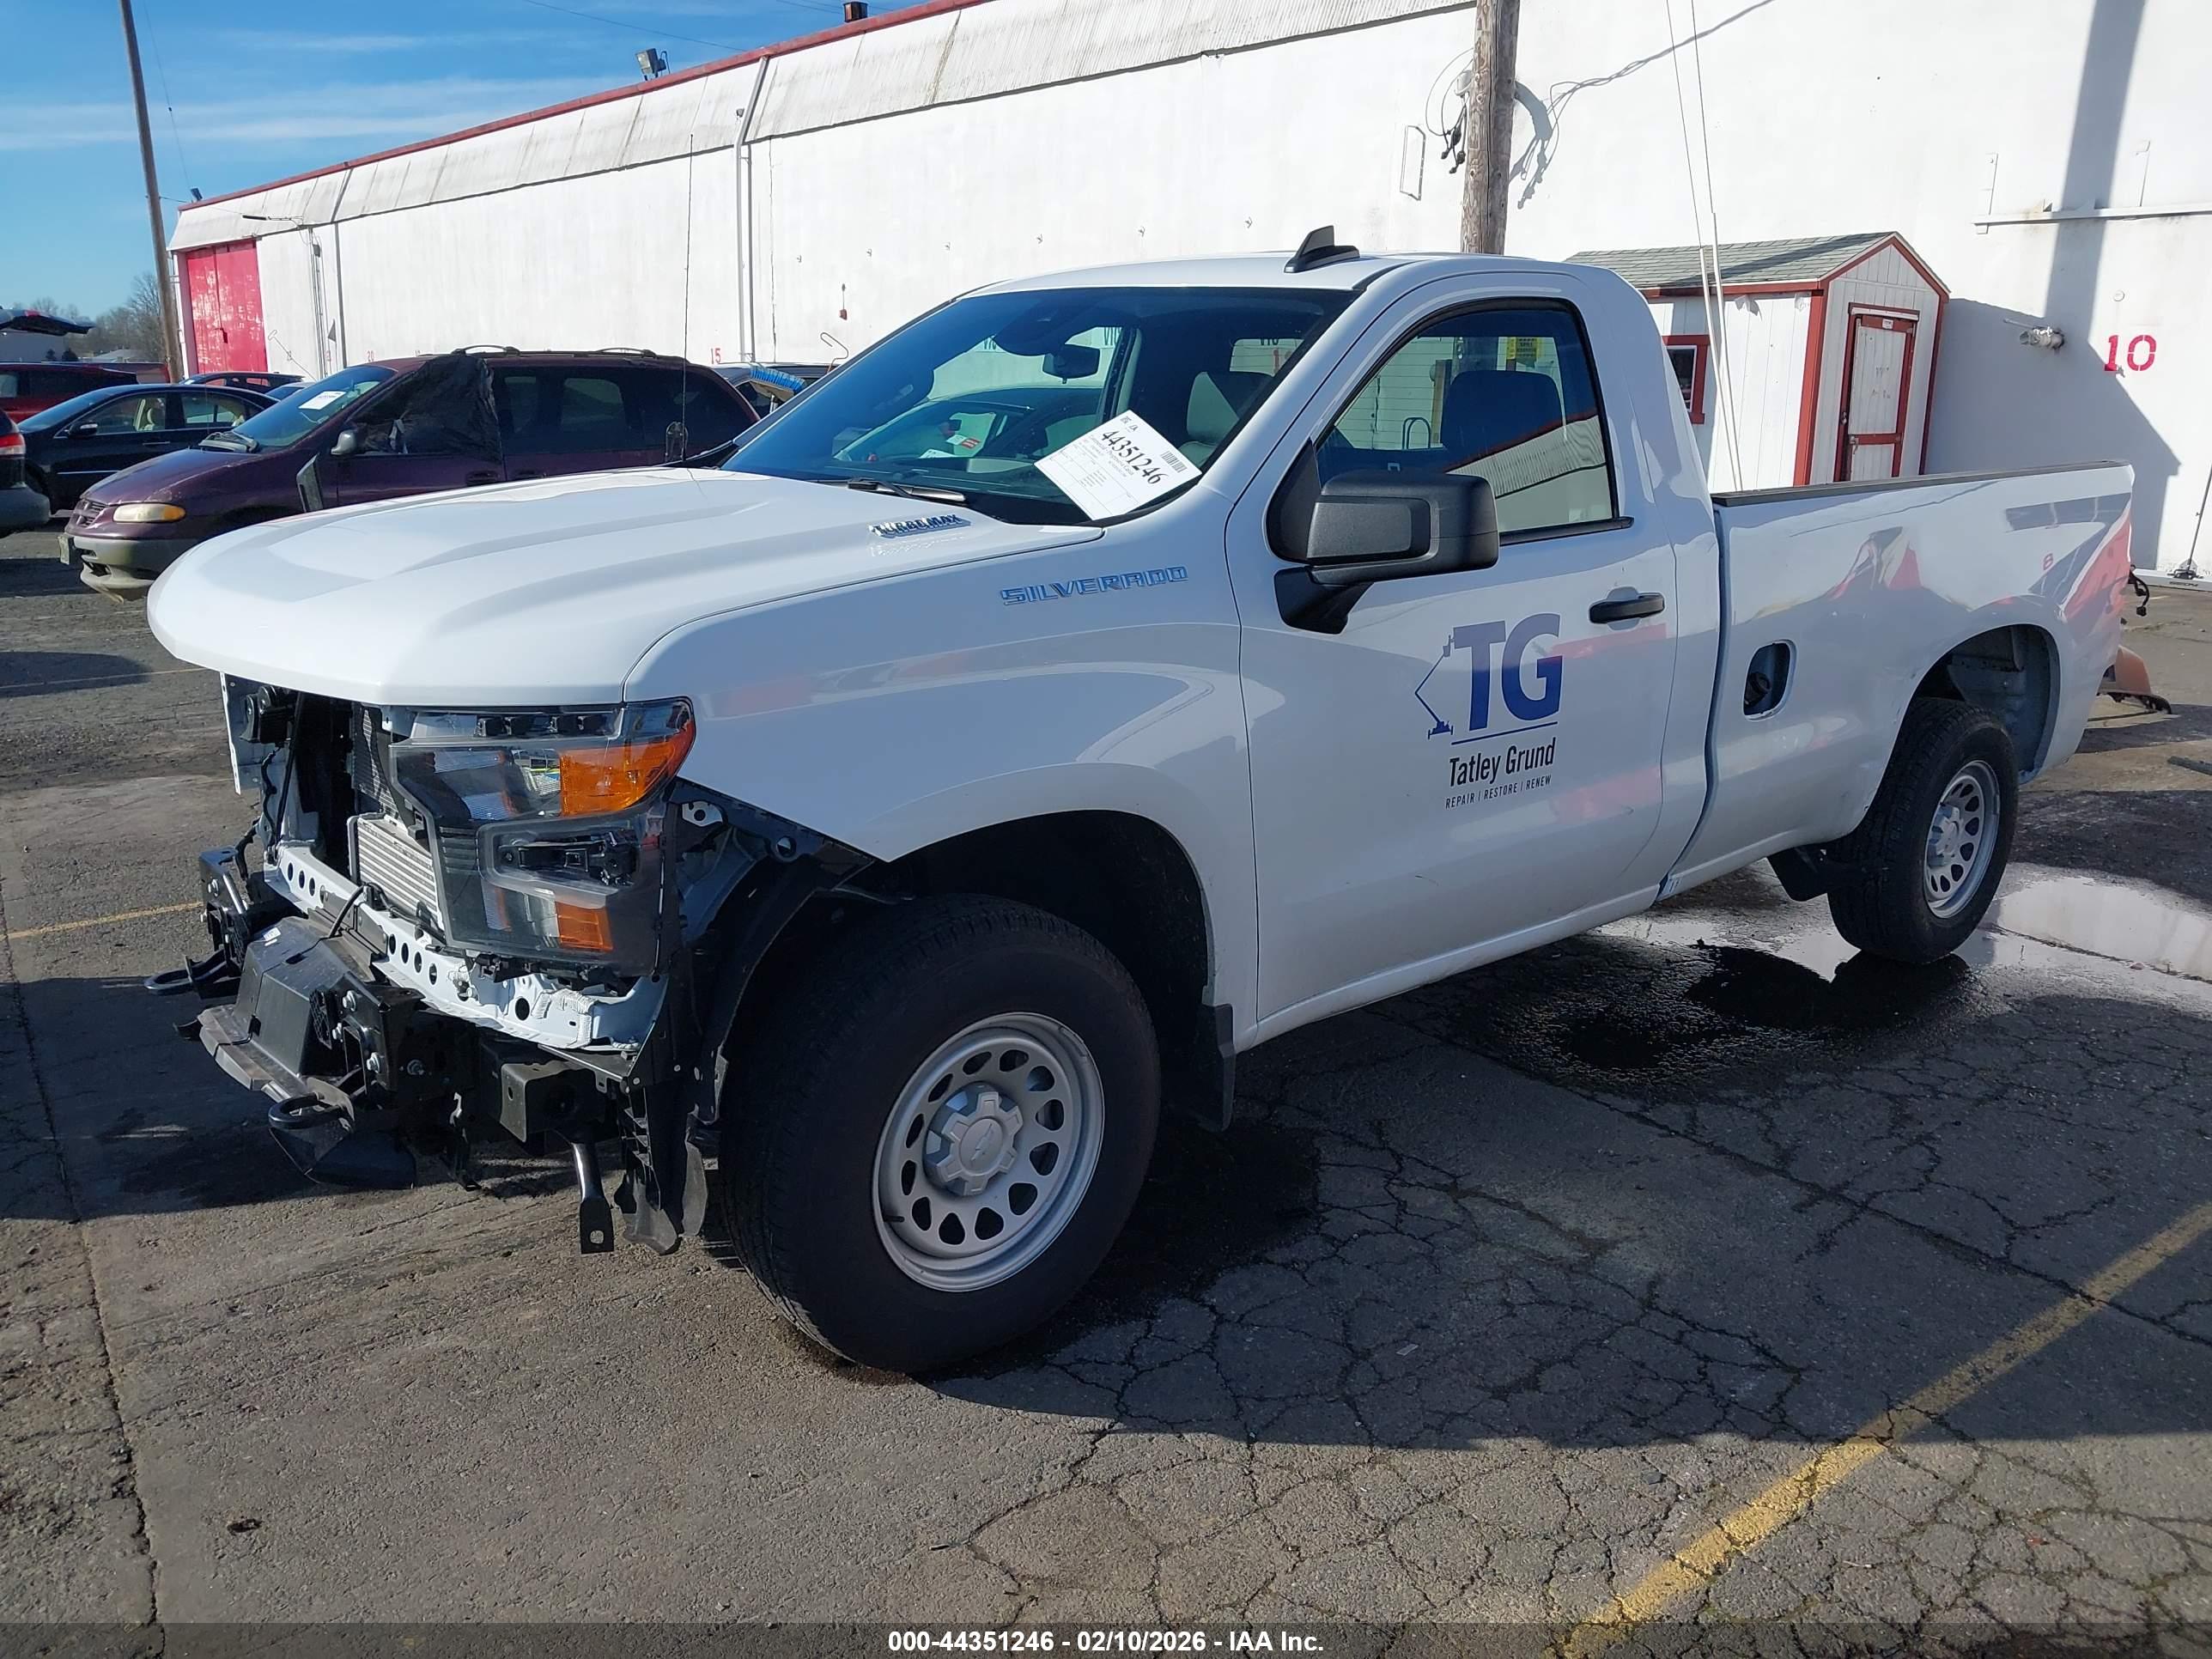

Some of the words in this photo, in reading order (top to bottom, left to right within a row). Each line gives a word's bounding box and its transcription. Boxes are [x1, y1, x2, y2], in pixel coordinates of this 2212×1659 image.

[711, 348, 721, 364] 15
[2105, 335, 2156, 371] 10
[1101, 429, 1170, 484] 44351246
[869, 514, 963, 538] TURBOMAX
[1000, 566, 1188, 605] SILVERADO
[1453, 613, 1563, 732] TG
[1449, 751, 1502, 787] Tatley
[1505, 737, 1556, 775] Grund
[1445, 793, 1475, 810] REPAIR
[1484, 782, 1518, 800] RESTORE
[1526, 774, 1552, 791] RENEW
